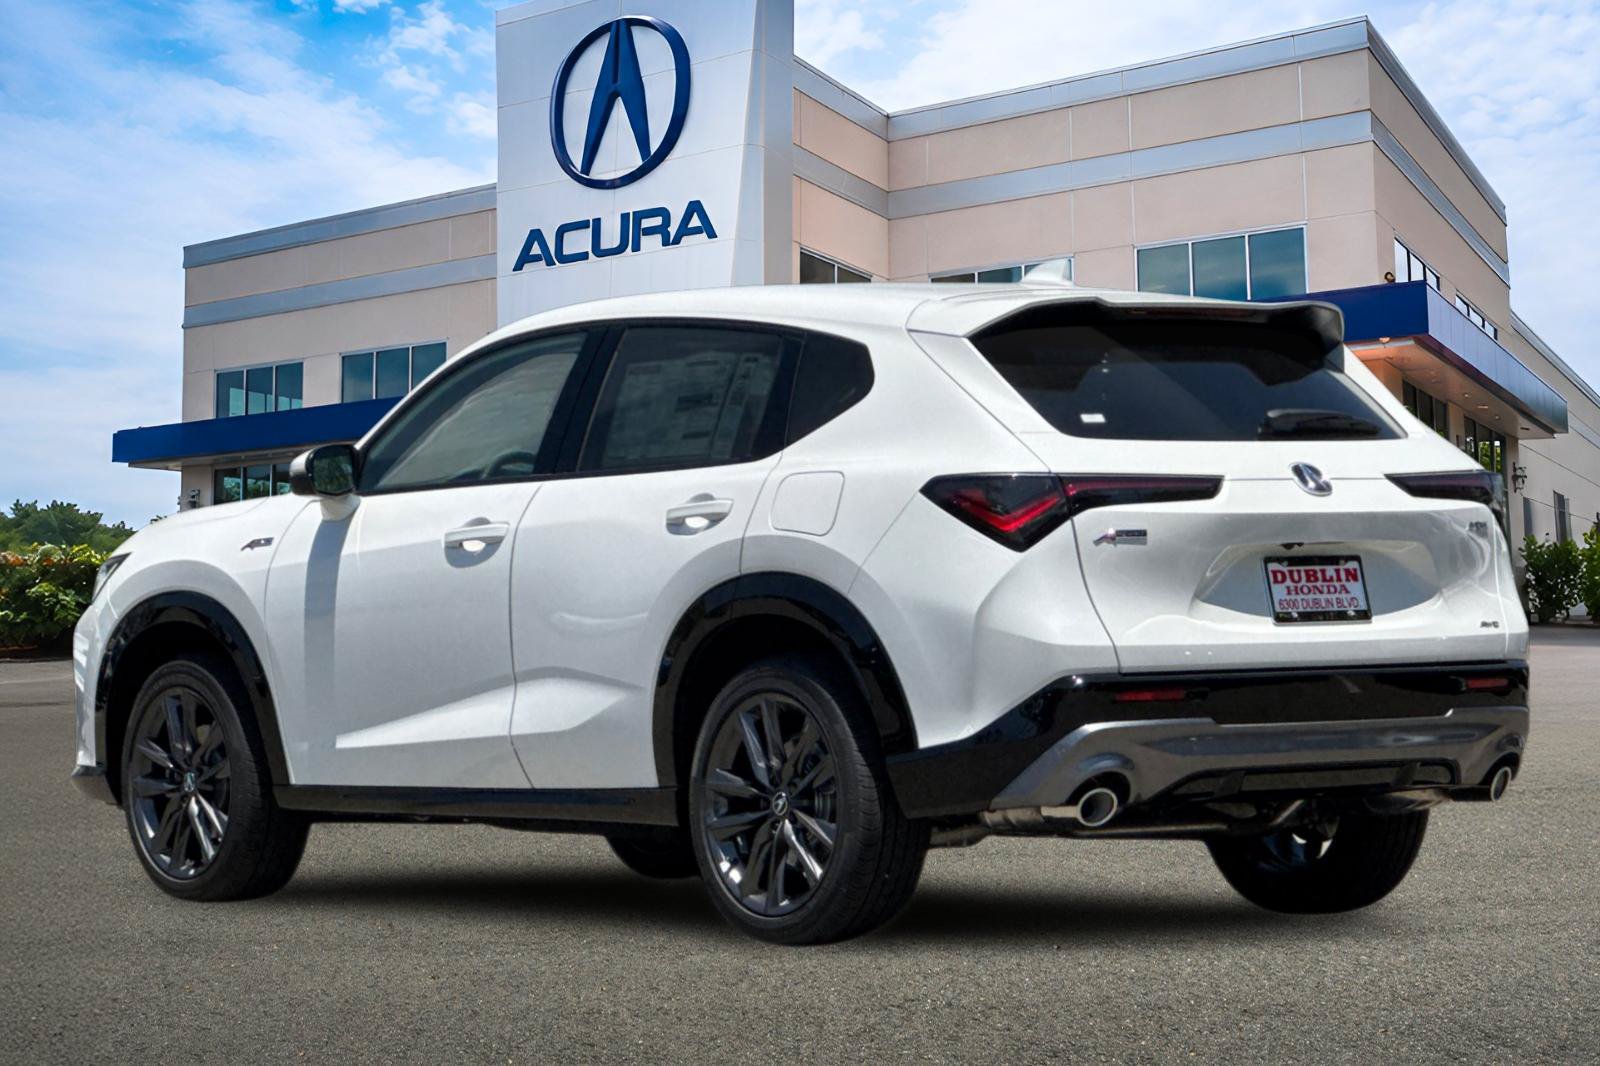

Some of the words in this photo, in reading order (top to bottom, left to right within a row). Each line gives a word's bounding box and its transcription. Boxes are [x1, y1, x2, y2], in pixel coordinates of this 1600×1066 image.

[512, 199, 718, 272] ACURA
[1271, 567, 1359, 584] DUBLIN
[1285, 584, 1350, 596] HONDA
[1302, 597, 1334, 609] DUBLIN
